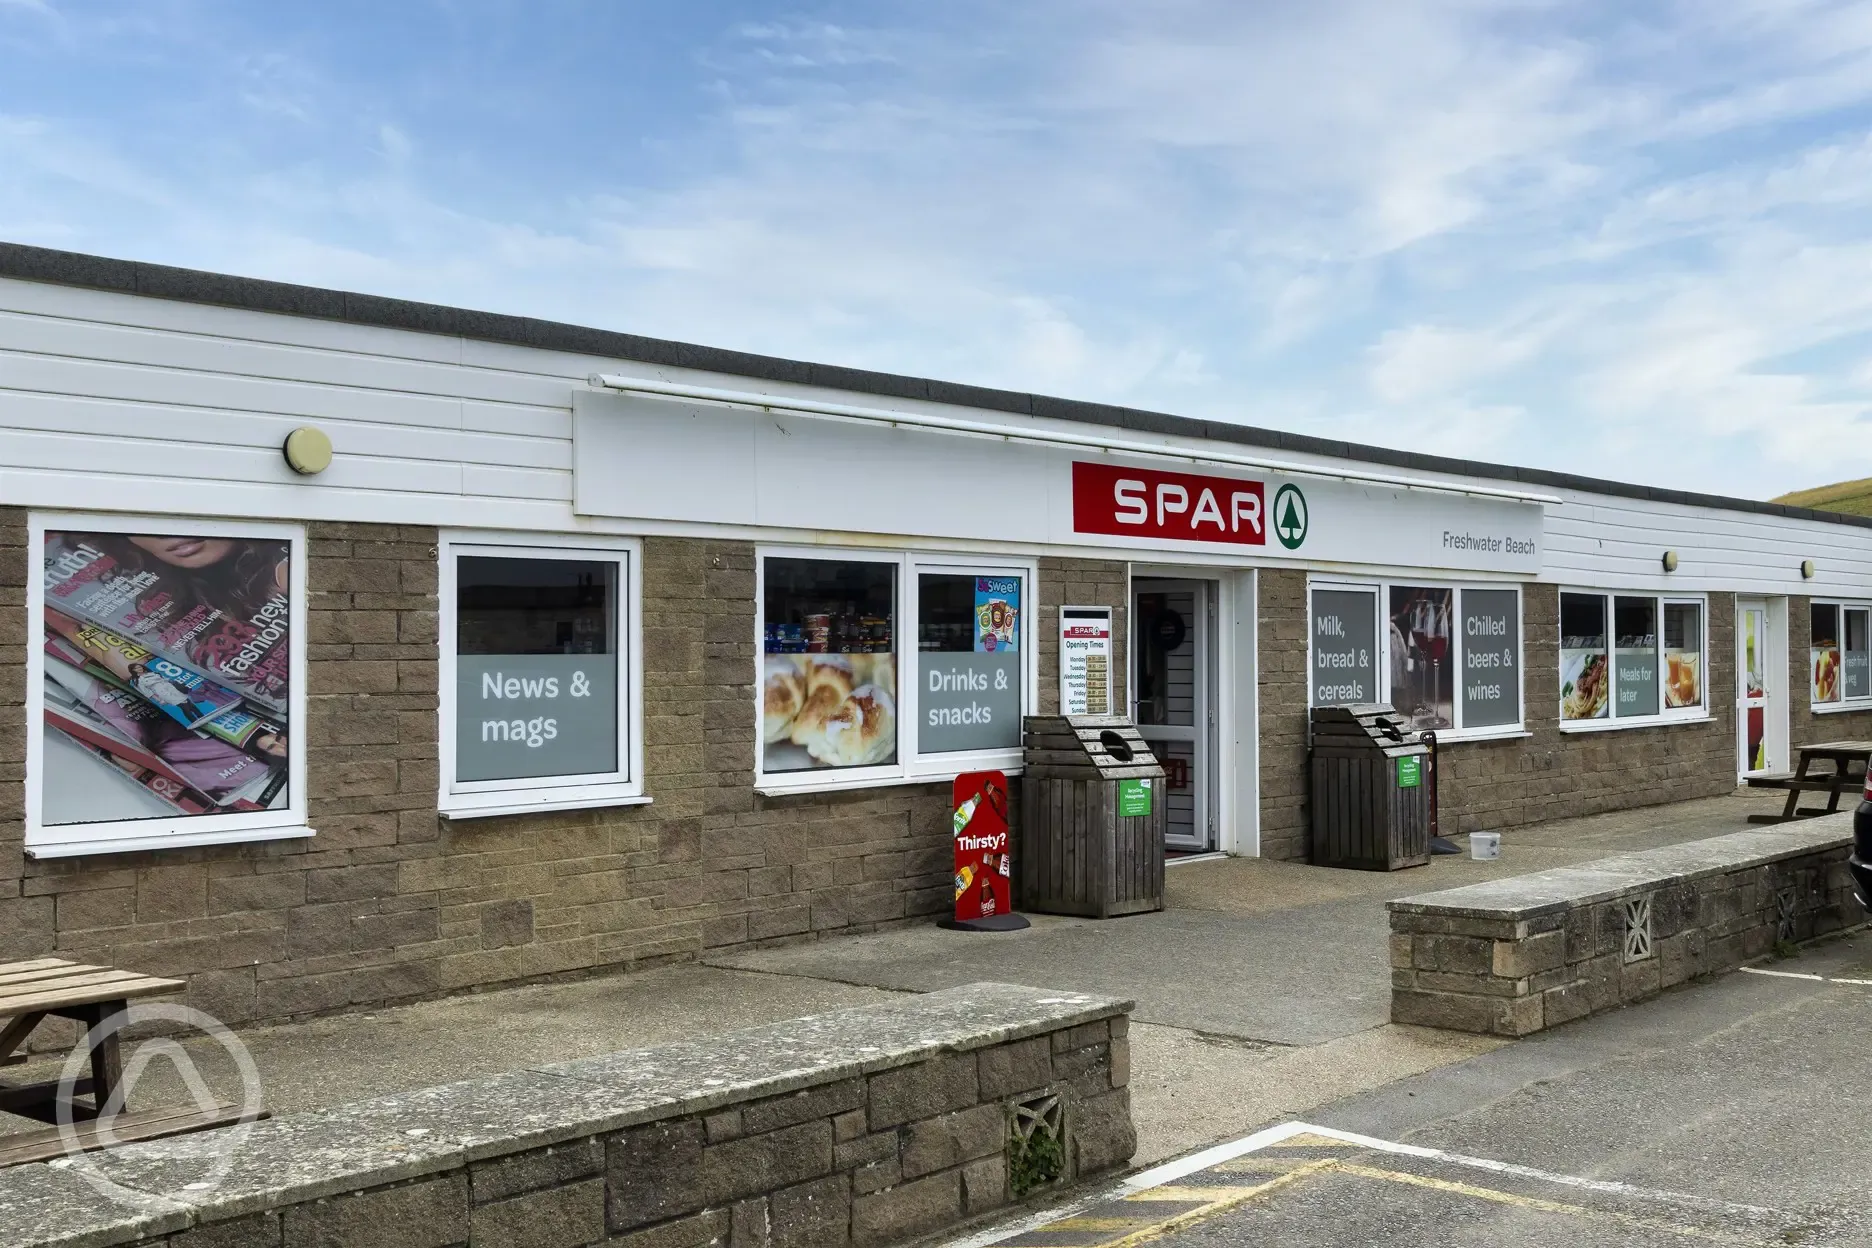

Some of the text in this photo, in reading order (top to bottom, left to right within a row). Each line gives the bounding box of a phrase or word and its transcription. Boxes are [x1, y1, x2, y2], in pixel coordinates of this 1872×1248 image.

[1114, 478, 1262, 535] SPAR
[1443, 530, 1536, 555] Freshwater Beach
[250, 593, 288, 628] new
[1317, 616, 1346, 638] Milk,
[1467, 616, 1506, 636] Chilled
[219, 619, 288, 677] fashion
[1066, 641, 1104, 650] Opening Times
[1318, 648, 1369, 668] bread &
[1467, 649, 1513, 668] beers &
[929, 668, 1008, 692] Drinks &
[1620, 666, 1652, 681] Meals for
[482, 670, 591, 700] News &
[1318, 680, 1363, 700] cereals
[1468, 680, 1501, 701] wines
[1620, 688, 1638, 702] later
[928, 701, 992, 726] snacks
[482, 716, 558, 748] mags
[218, 760, 247, 779] Meet
[957, 832, 1007, 851] Thirsty?
